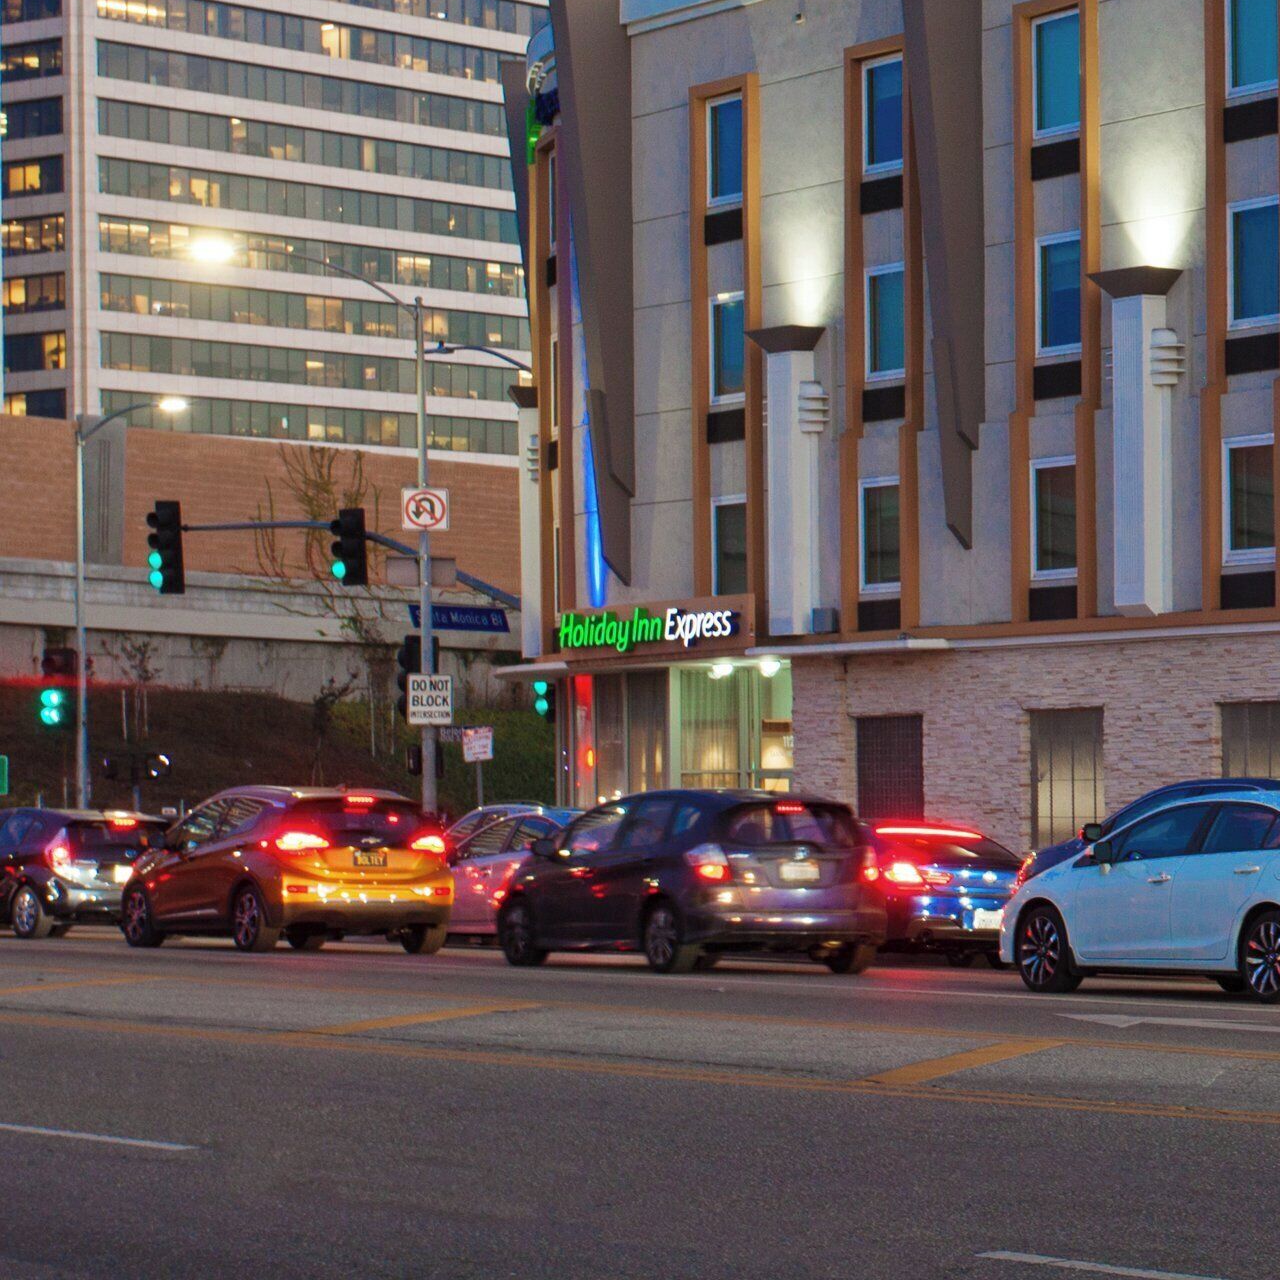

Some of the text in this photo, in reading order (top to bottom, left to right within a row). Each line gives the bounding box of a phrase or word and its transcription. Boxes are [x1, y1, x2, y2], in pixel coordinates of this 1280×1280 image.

[450, 610, 488, 625] Monica
[560, 607, 732, 652] Holiday Inn Express
[412, 679, 449, 691] DO NOT
[412, 695, 449, 707] BLOCK
